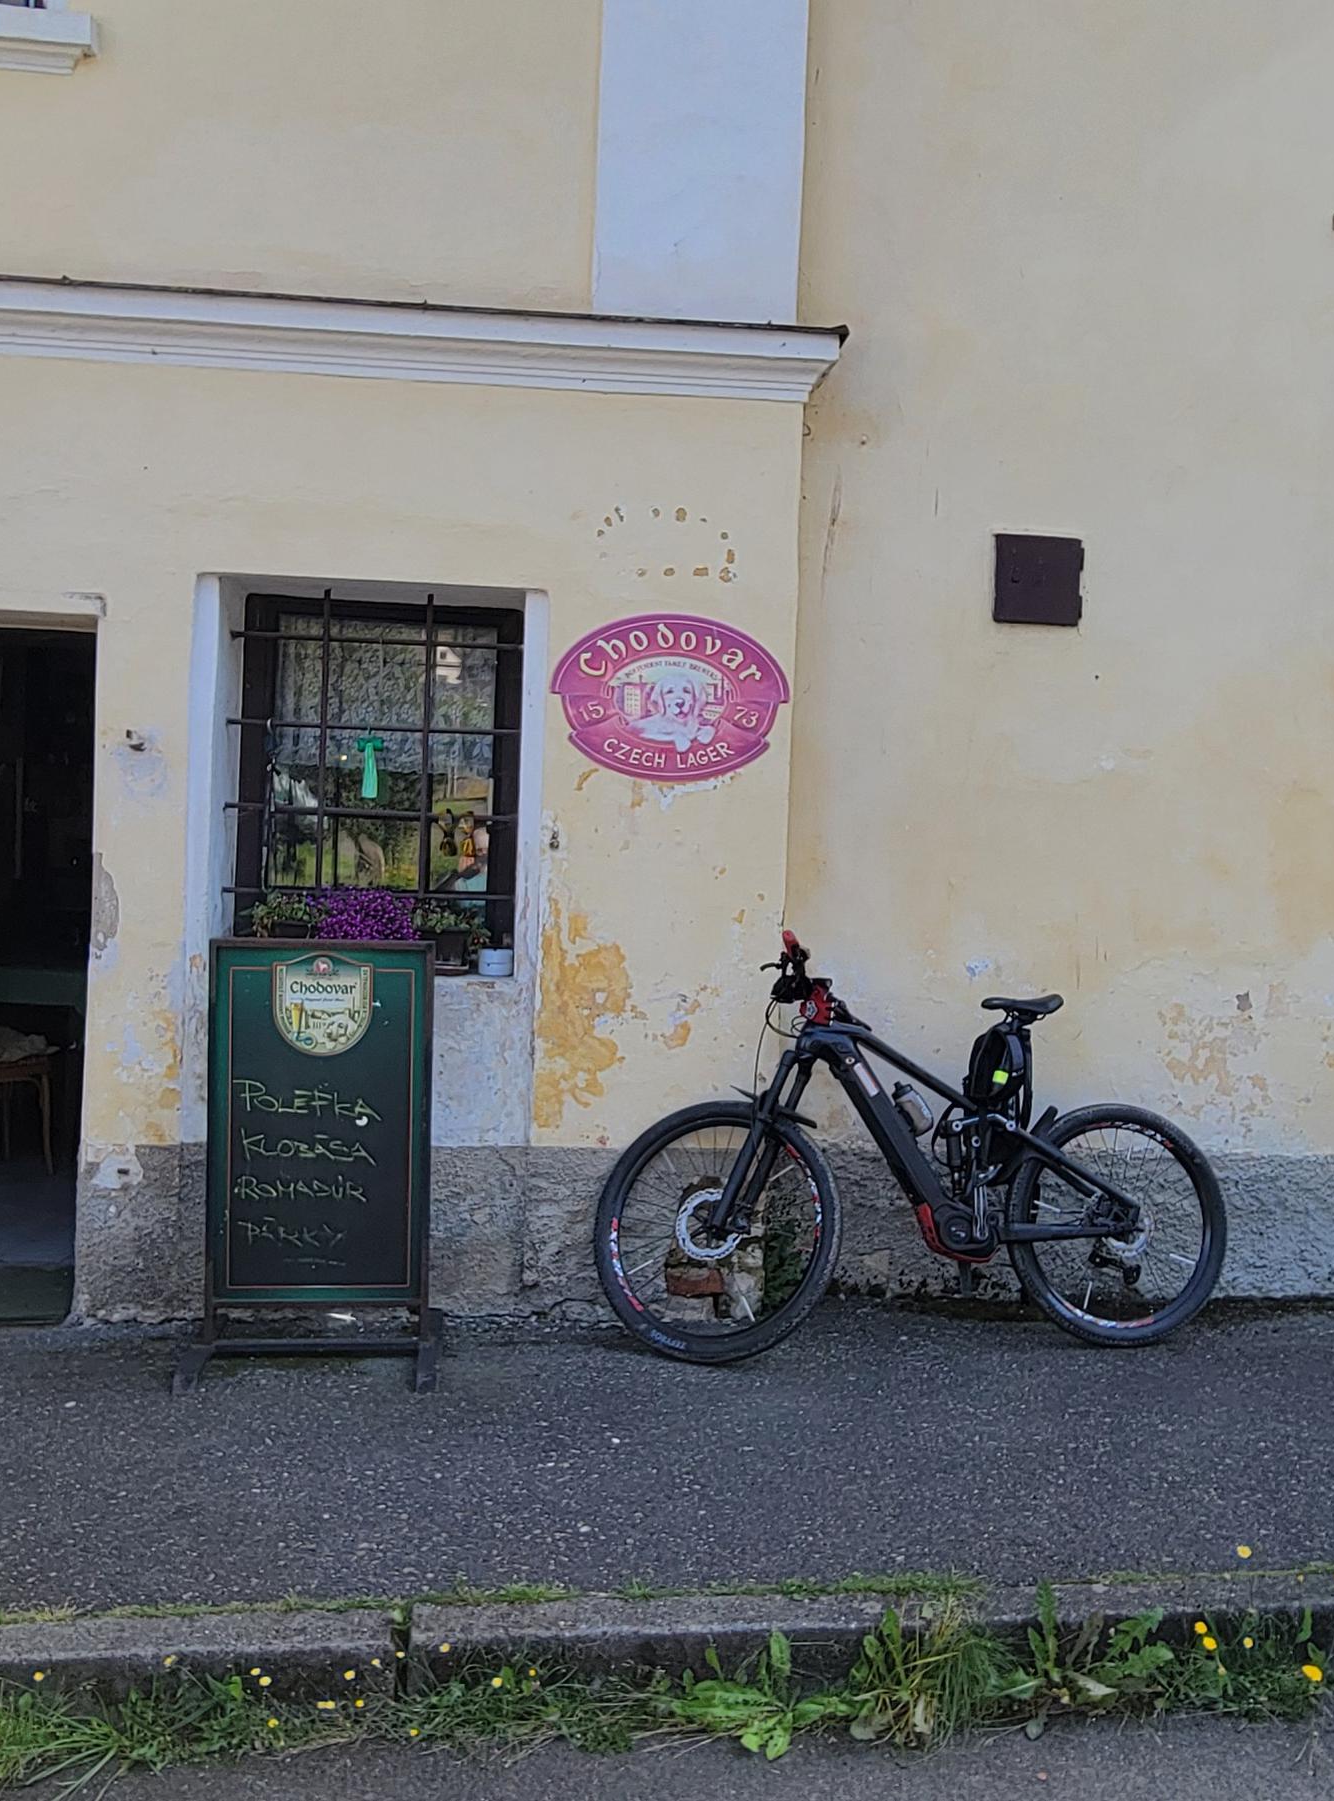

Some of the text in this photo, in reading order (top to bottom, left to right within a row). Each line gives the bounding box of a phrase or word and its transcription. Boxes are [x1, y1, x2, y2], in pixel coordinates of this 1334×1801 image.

[578, 622, 763, 683] Chodovar
[578, 700, 760, 730] 15 73
[603, 738, 736, 769] CZECH LAGER
[289, 980, 357, 996] Chodovar
